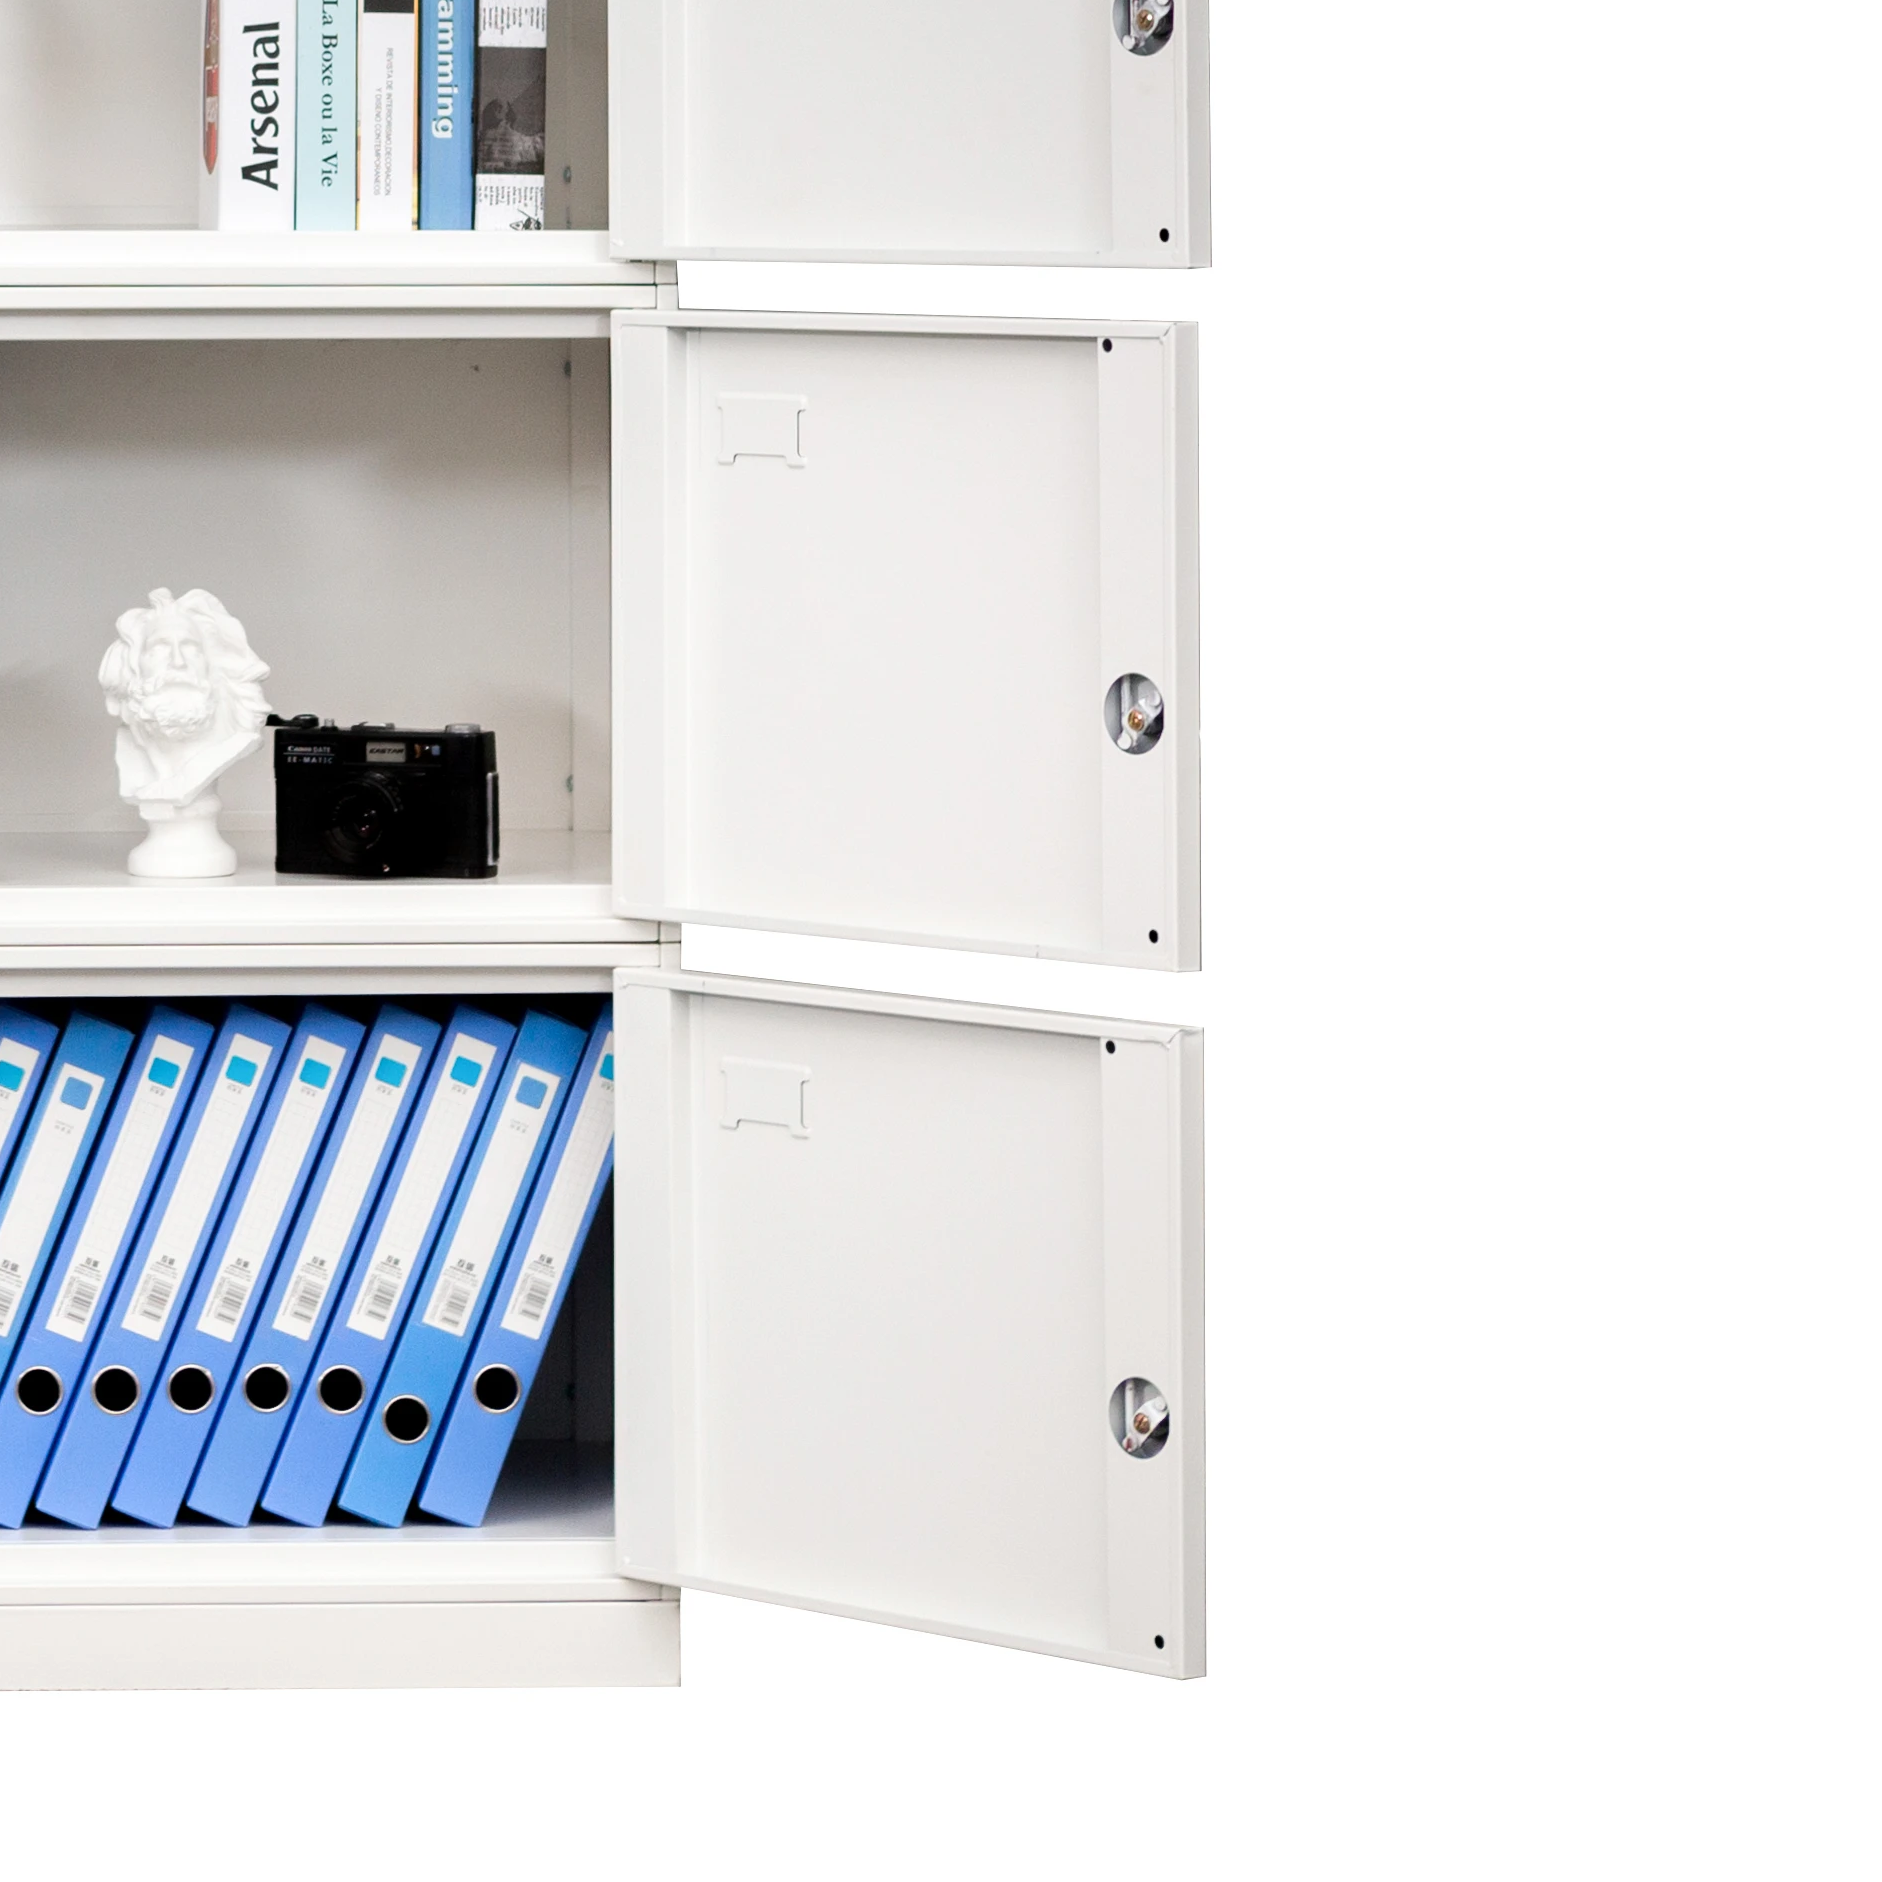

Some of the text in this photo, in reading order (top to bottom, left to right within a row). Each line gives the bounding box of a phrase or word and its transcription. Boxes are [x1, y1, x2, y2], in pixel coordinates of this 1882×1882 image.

[322, 34, 339, 87] Boxe
[386, 80, 393, 90] DE
[241, 21, 281, 191] Arsenal
[321, 93, 334, 120] ou
[321, 127, 338, 146] la
[321, 152, 338, 188] Vie
